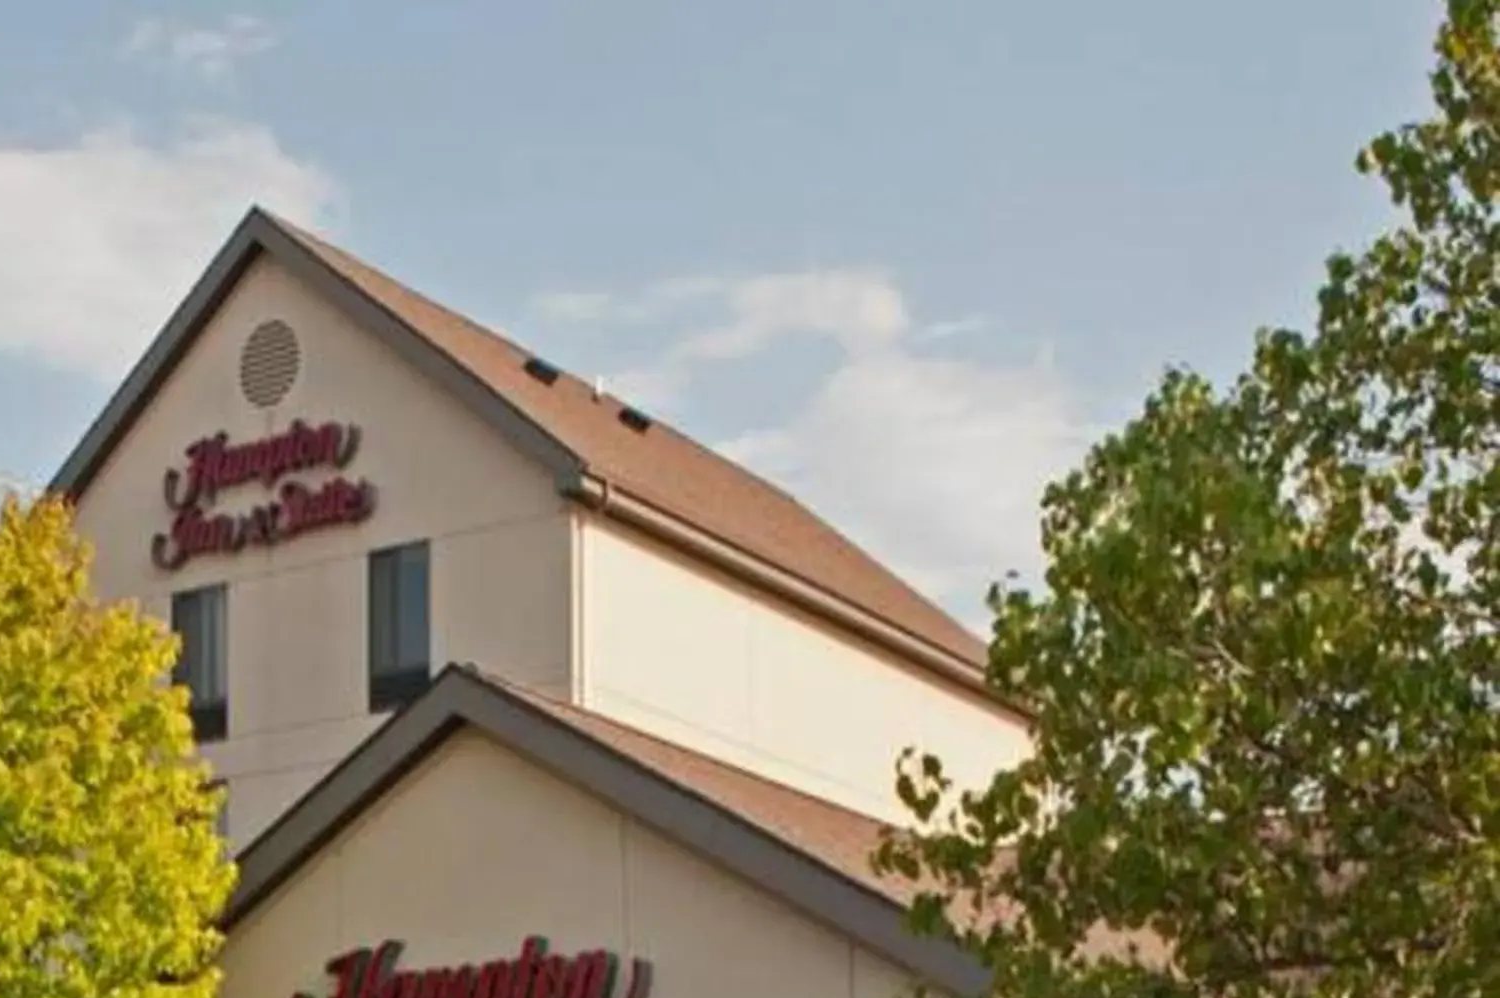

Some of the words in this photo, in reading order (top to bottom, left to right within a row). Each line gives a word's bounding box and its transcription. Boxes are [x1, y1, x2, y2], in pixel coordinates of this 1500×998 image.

[164, 418, 361, 511] Hampton
[152, 505, 249, 571] Inn
[268, 477, 378, 542] Suites
